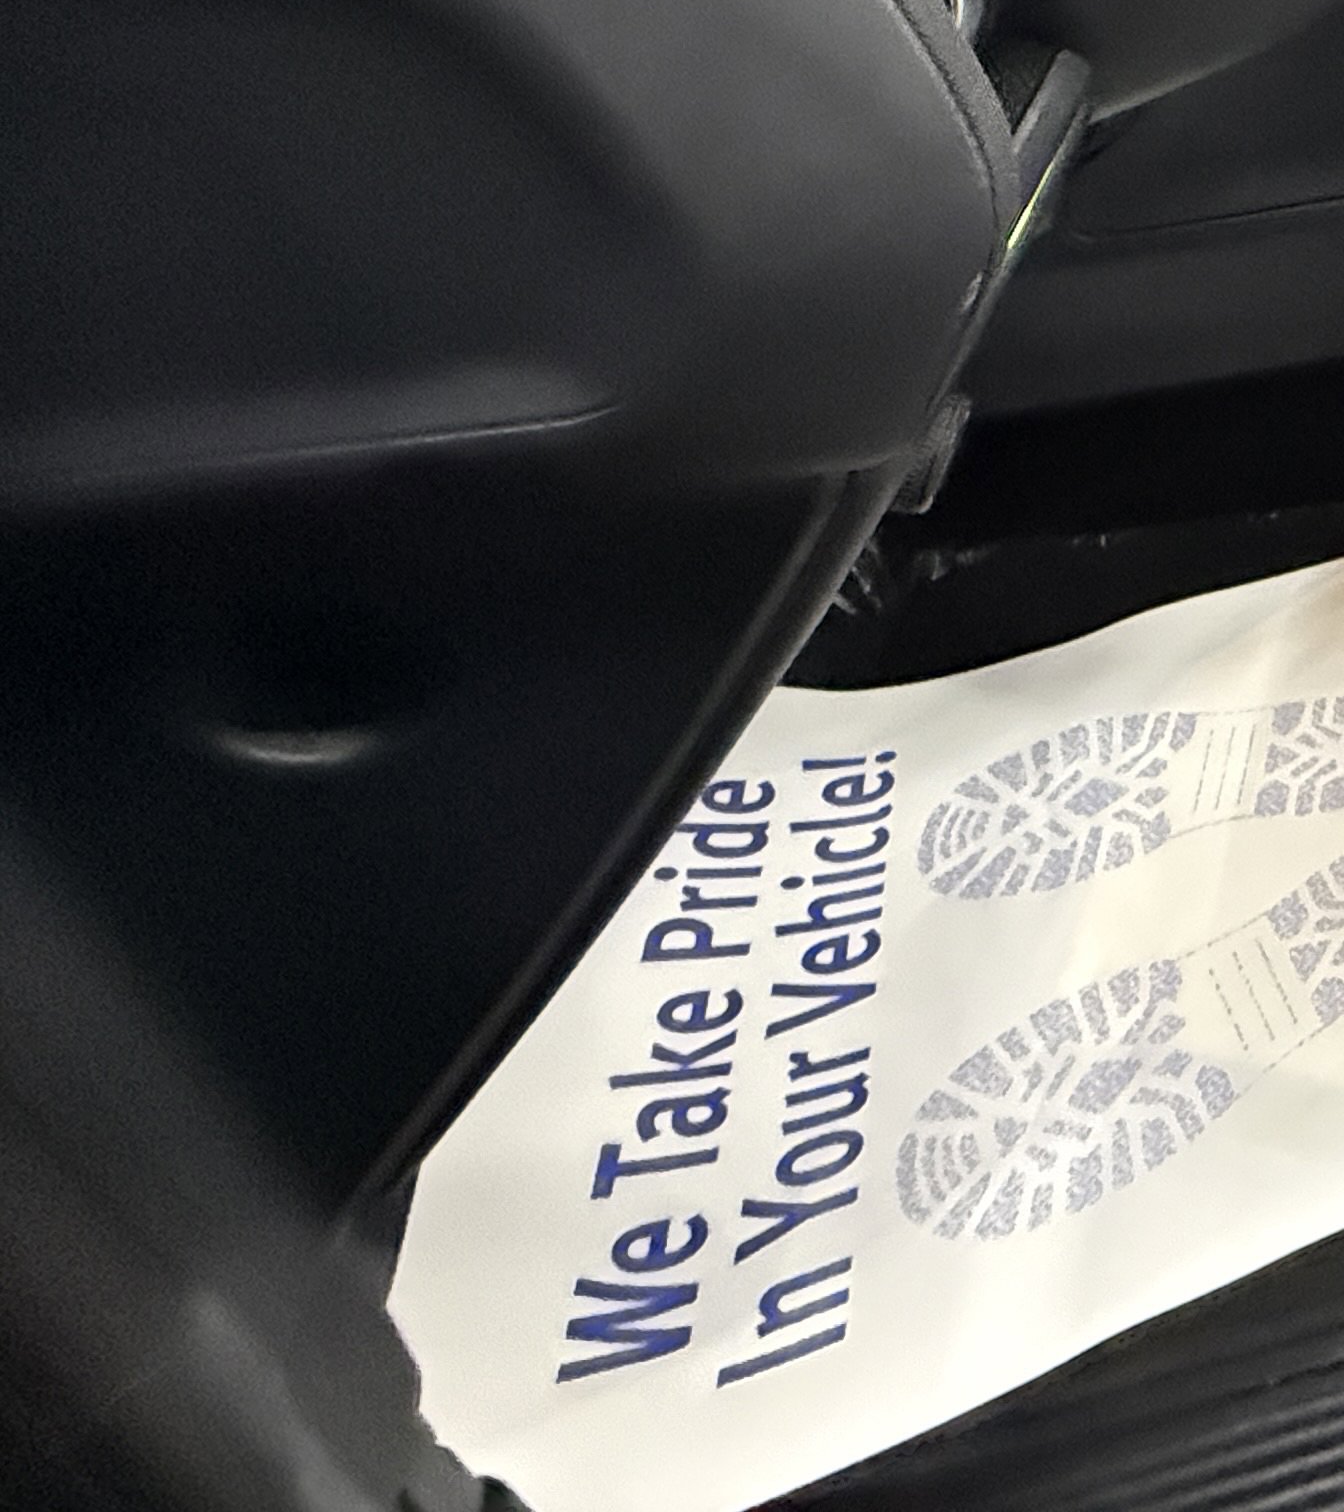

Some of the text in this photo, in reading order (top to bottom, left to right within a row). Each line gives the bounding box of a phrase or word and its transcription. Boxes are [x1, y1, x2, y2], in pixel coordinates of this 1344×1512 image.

[556, 777, 776, 1384] We Take Pride
[716, 749, 897, 1389] In Your Vehicle!
